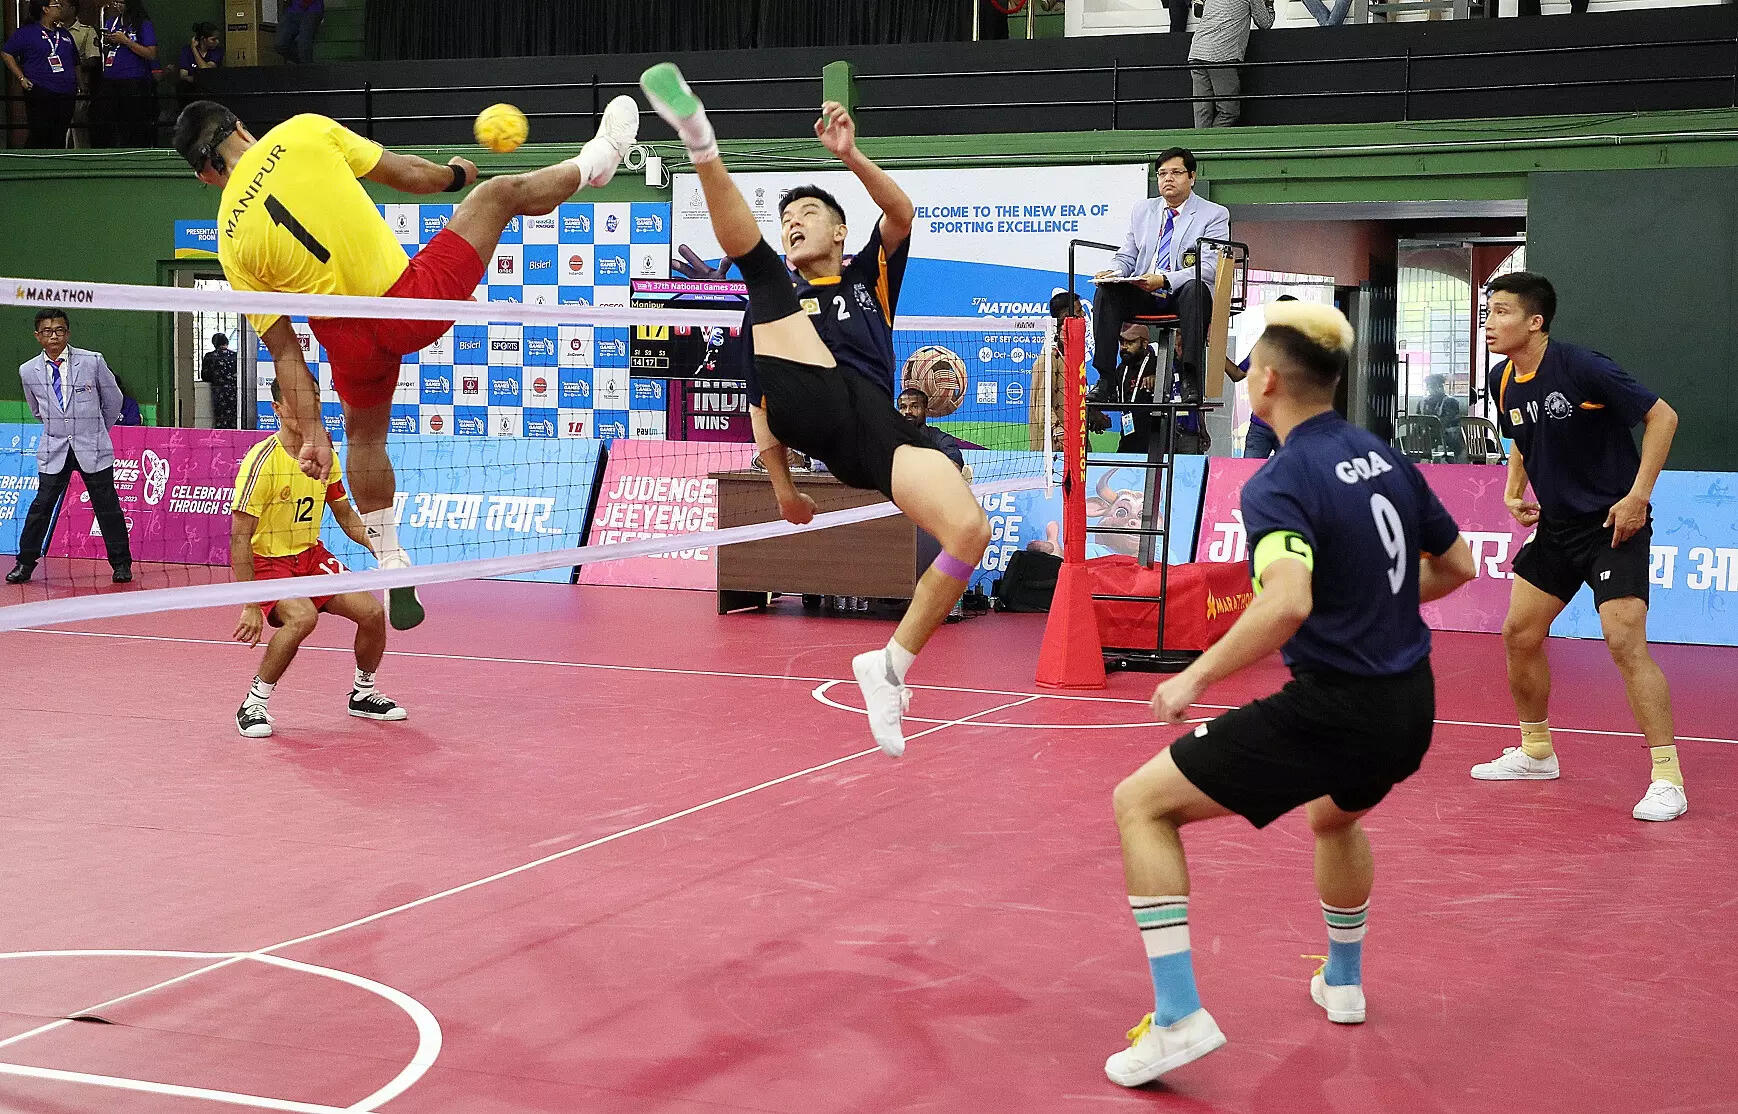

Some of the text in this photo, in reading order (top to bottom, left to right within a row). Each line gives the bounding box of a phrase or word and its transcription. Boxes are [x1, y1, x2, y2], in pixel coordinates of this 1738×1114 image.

[225, 145, 286, 238] MANIPUR
[973, 206, 991, 218] TO
[995, 206, 1020, 218] THE
[1023, 205, 1057, 217] NEW
[1060, 205, 1087, 217] ERA
[1090, 204, 1109, 217] OF
[264, 193, 331, 264] 1
[930, 220, 1079, 233] SPORTING EXCELLENCE
[529, 260, 552, 270] Bisleri
[653, 283, 671, 291] 37th
[671, 283, 702, 291] National
[26, 288, 94, 303] MARATHON
[631, 300, 665, 308] Manipur
[832, 295, 851, 321] 2
[977, 302, 1051, 314] NATIONAL
[984, 335, 998, 343] GET
[999, 335, 1013, 343] SET
[633, 358, 642, 366] 14
[993, 351, 1007, 360] Oct
[1526, 400, 1539, 423] 10
[694, 416, 729, 430] WINS
[1335, 451, 1393, 484] GOA
[608, 475, 717, 504] JUDENGE
[169, 499, 220, 514] THROUGH
[294, 496, 314, 523] 12
[409, 493, 484, 529] आसा
[595, 502, 717, 532] JEEYENGE
[1370, 492, 1406, 595] 9
